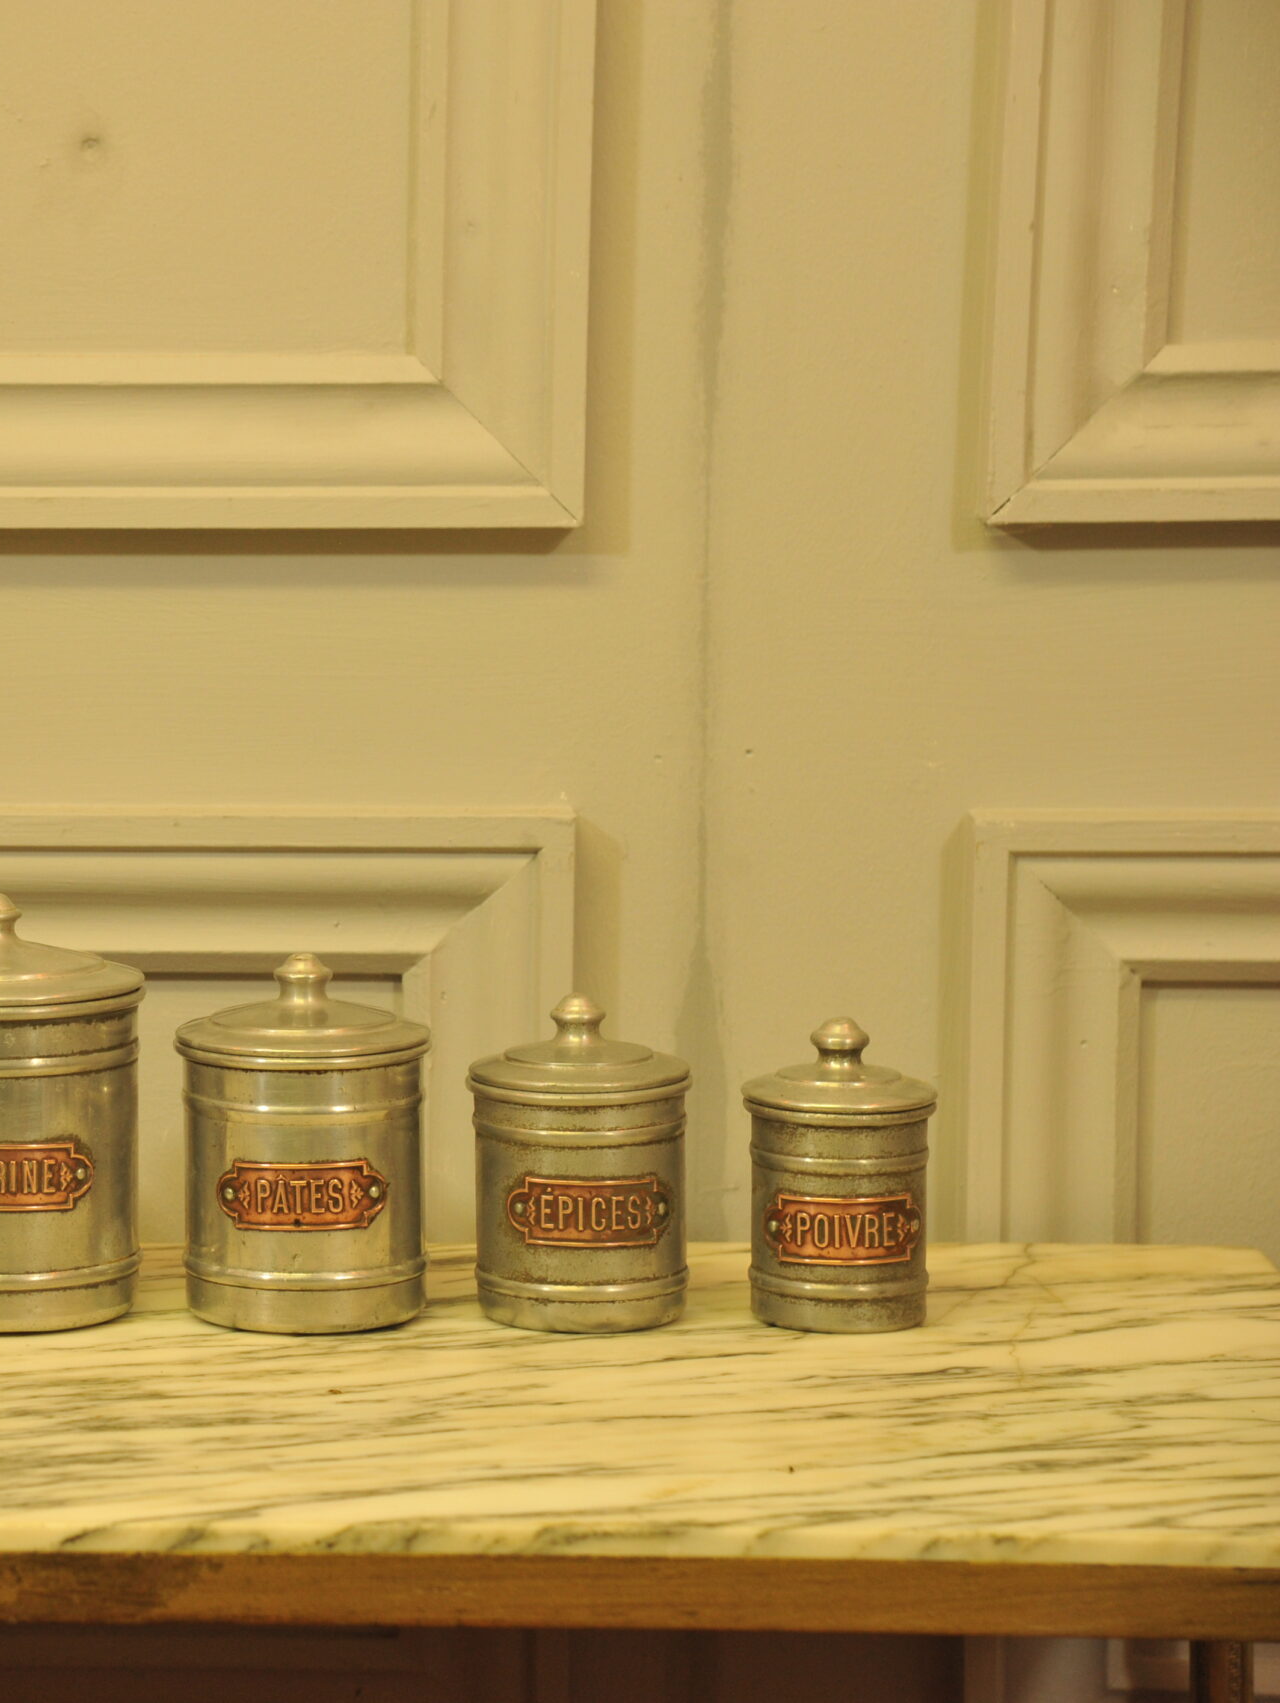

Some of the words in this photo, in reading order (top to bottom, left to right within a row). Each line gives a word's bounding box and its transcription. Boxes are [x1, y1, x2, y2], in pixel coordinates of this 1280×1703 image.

[256, 1174, 345, 1214] PÂTES
[540, 1187, 642, 1231] ÉPICES
[796, 1212, 896, 1249] POIVRE
